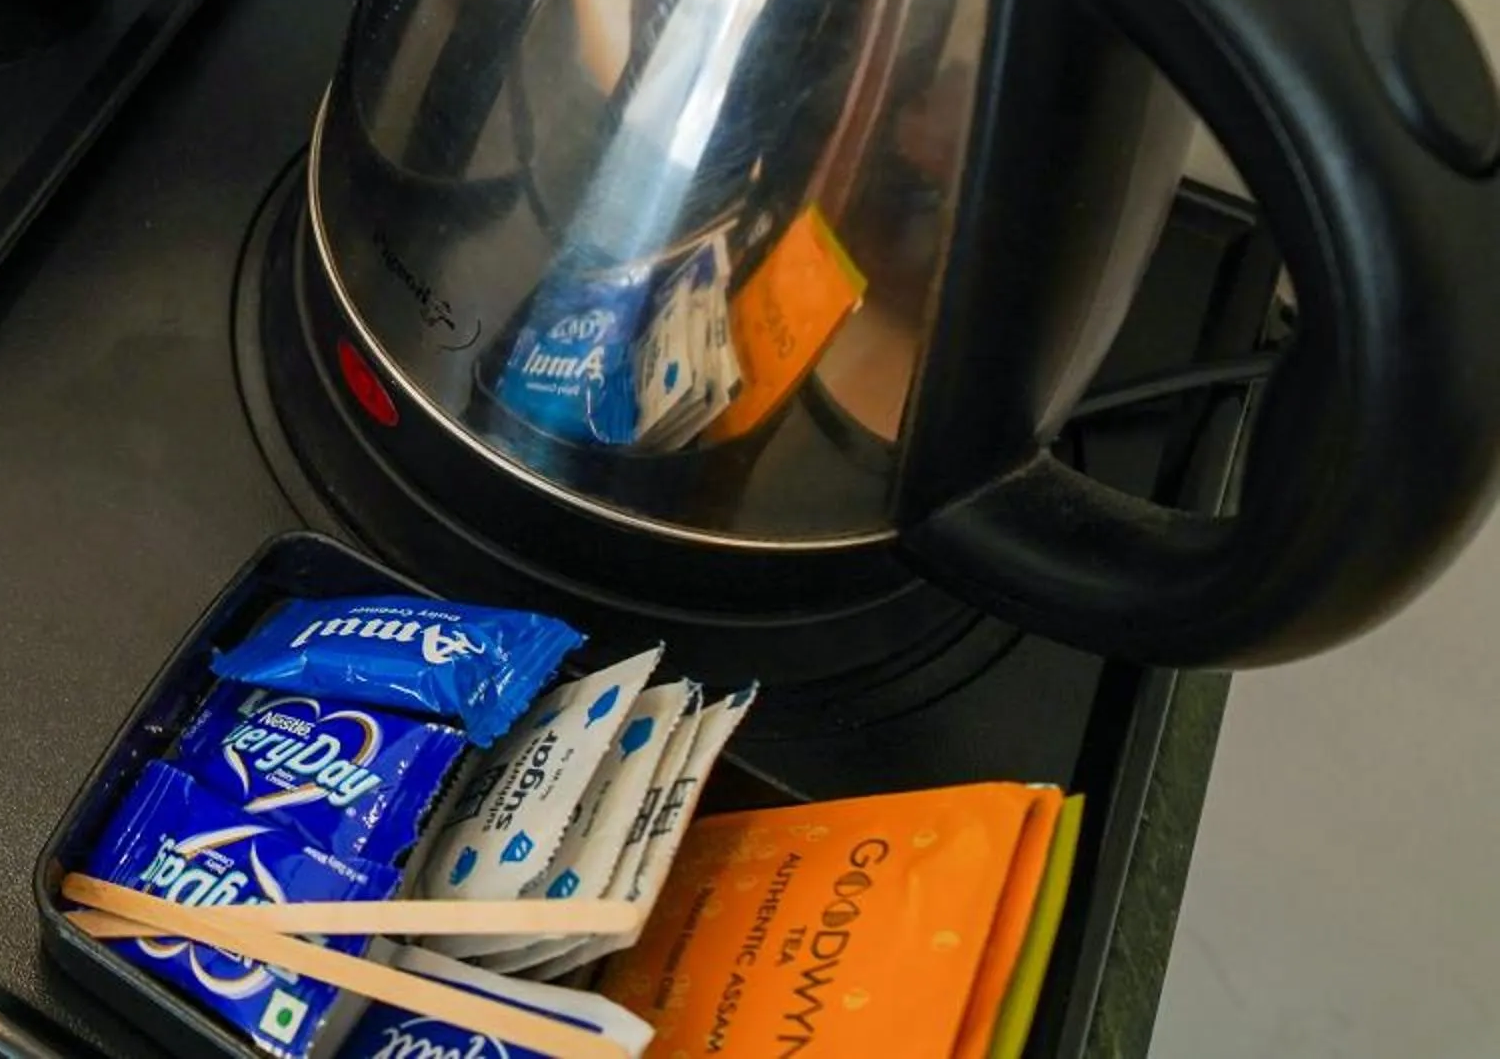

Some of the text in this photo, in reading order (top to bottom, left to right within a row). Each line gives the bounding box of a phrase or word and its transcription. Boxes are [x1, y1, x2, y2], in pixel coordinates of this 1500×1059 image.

[291, 617, 485, 664] Amul
[495, 731, 558, 831] sugar
[705, 852, 803, 1054] AUTHENTIC ASSAM
[774, 925, 807, 967] TEA
